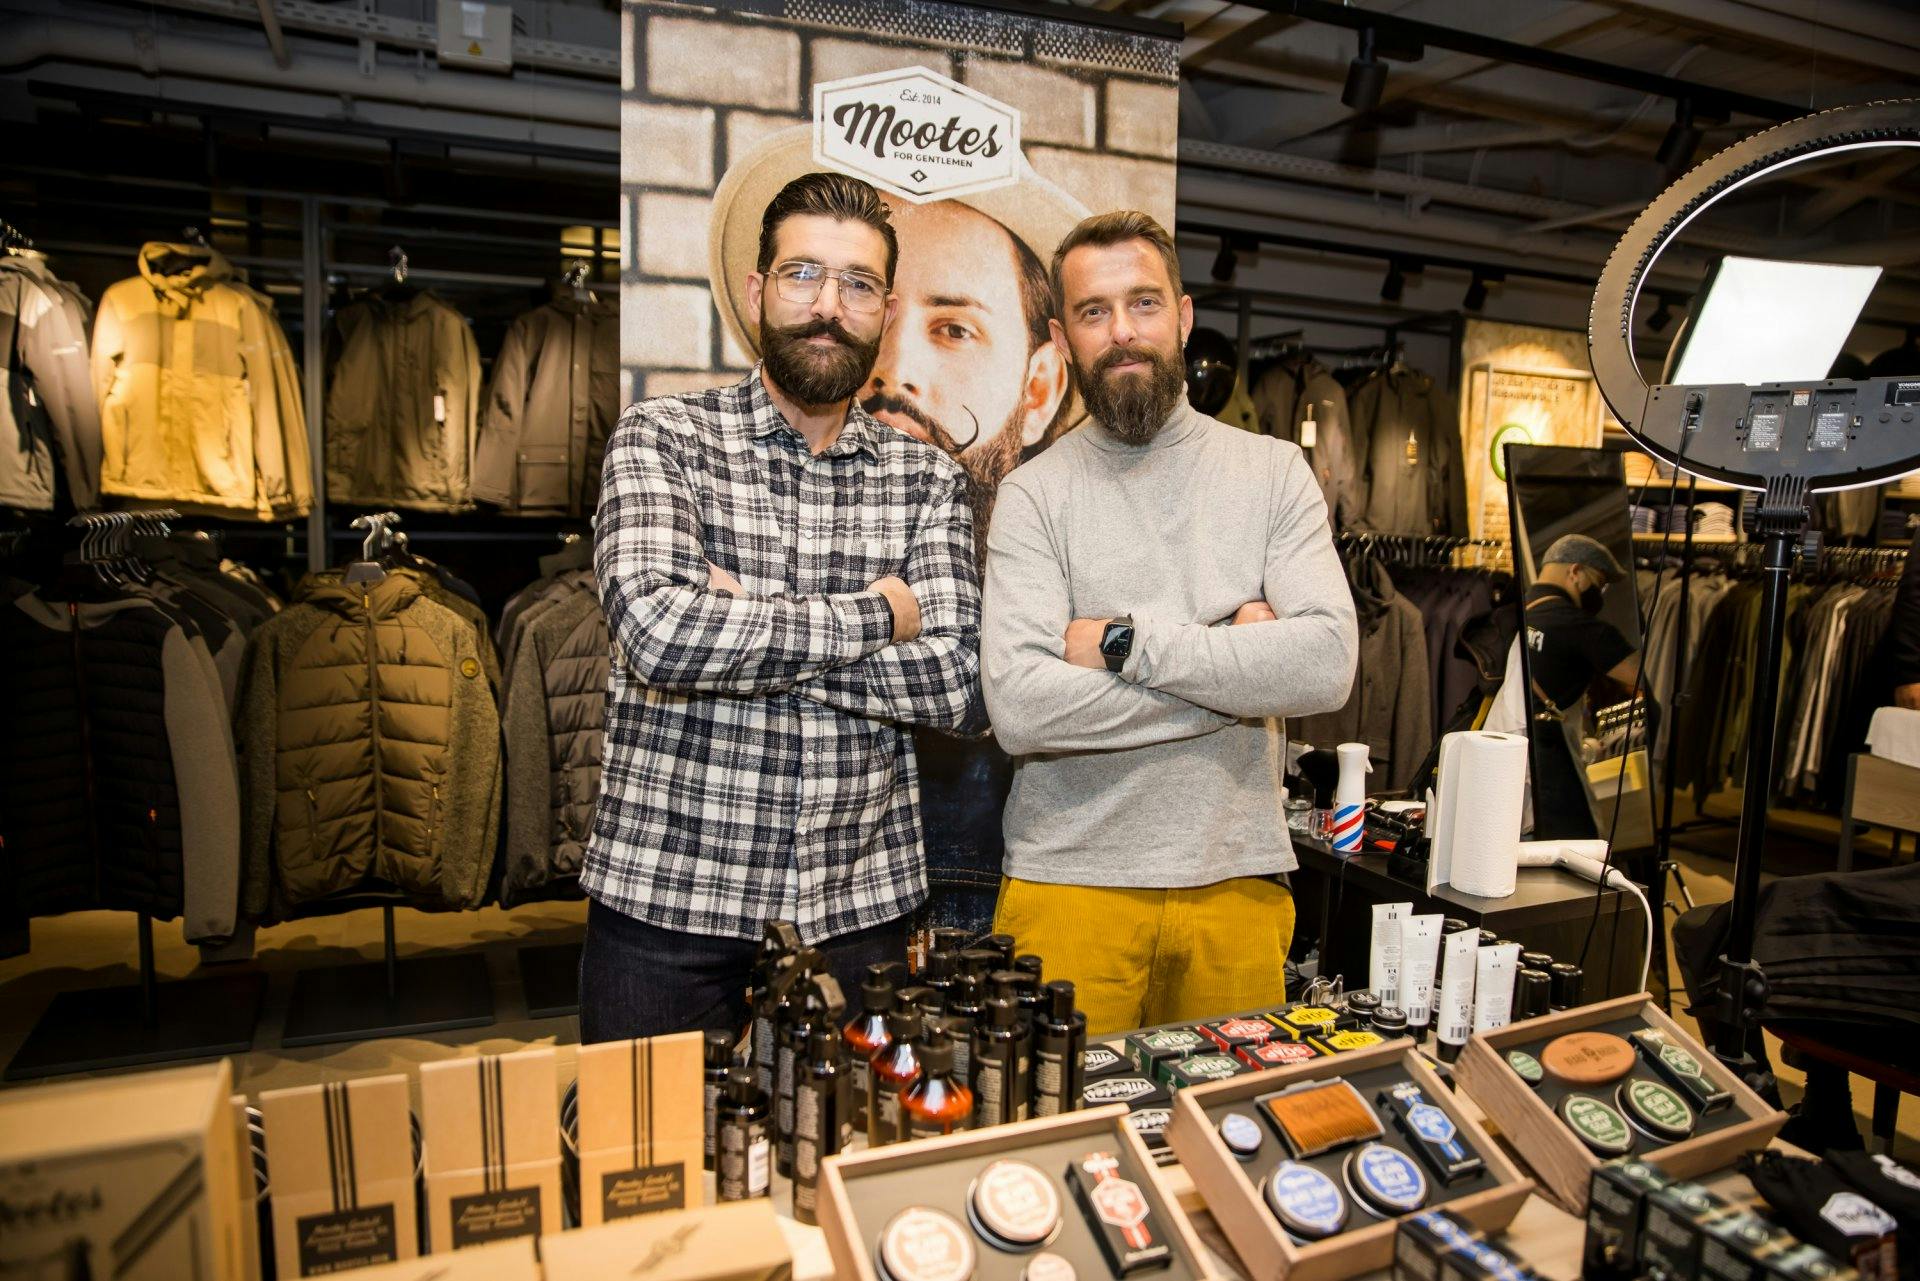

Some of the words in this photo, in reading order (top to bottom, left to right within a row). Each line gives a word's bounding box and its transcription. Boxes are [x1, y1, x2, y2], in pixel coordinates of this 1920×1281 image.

[899, 88, 921, 103] Est.
[922, 94, 941, 105] 2014
[833, 101, 1003, 158] Mootes
[894, 151, 913, 161] FOR
[915, 154, 973, 167] GENTLEMEN
[1296, 1011, 1332, 1022] SOAP
[1228, 1022, 1267, 1035] SOAP
[1154, 1032, 1194, 1048] SOAP
[1338, 1036, 1373, 1048] SOAP
[1266, 1046, 1308, 1059] SOAP
[1189, 1059, 1232, 1074] SOAP
